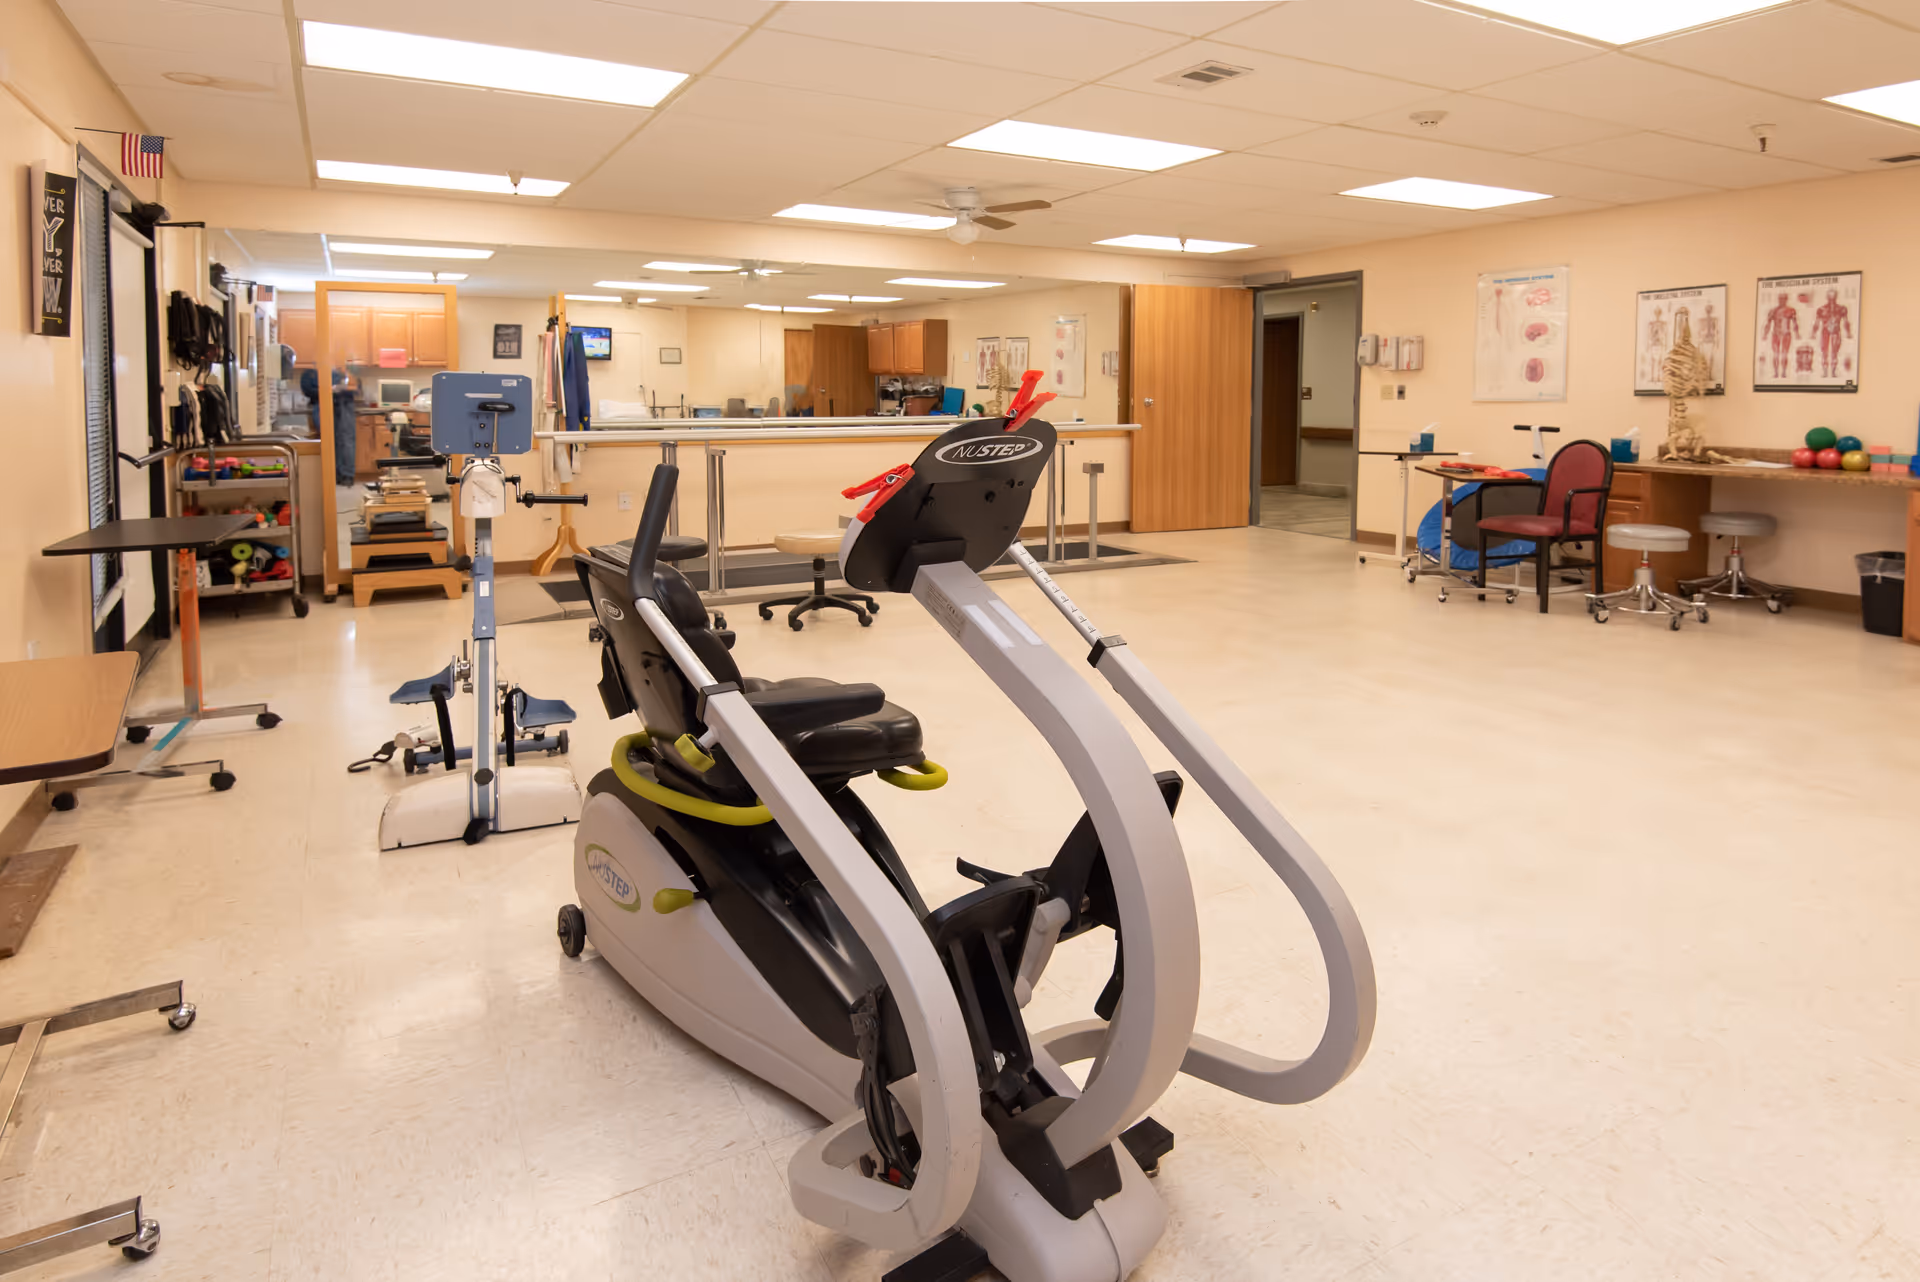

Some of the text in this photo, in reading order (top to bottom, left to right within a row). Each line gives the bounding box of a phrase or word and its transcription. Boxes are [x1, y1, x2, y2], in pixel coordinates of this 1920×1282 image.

[44, 197, 65, 213] VER
[43, 257, 63, 273] VER
[1812, 277, 1838, 285] SYSTEM
[952, 444, 1026, 459] NUSTEP
